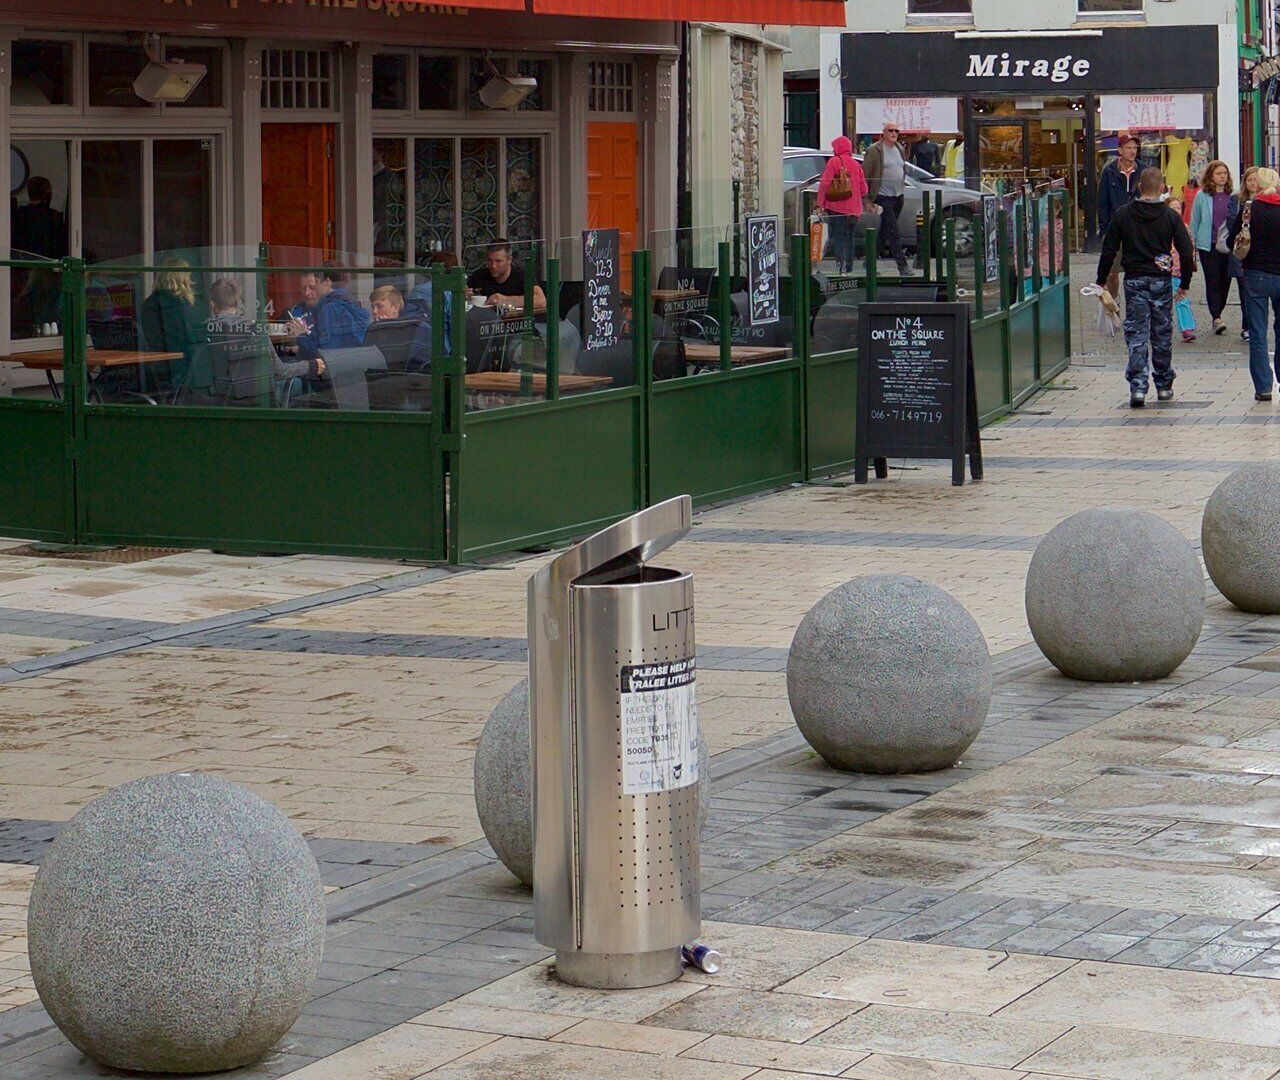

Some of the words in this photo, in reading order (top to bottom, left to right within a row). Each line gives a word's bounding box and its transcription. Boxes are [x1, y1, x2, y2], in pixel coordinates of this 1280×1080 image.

[966, 52, 1090, 83] Mirage
[1127, 103, 1176, 126] SALE
[595, 260, 613, 278] 12-3
[207, 322, 223, 333] ON
[228, 322, 252, 333] THE
[506, 320, 533, 332] SQUARE
[911, 330, 945, 340] SQUARE
[632, 666, 669, 677] PLEASE
[627, 746, 653, 755] 50050
